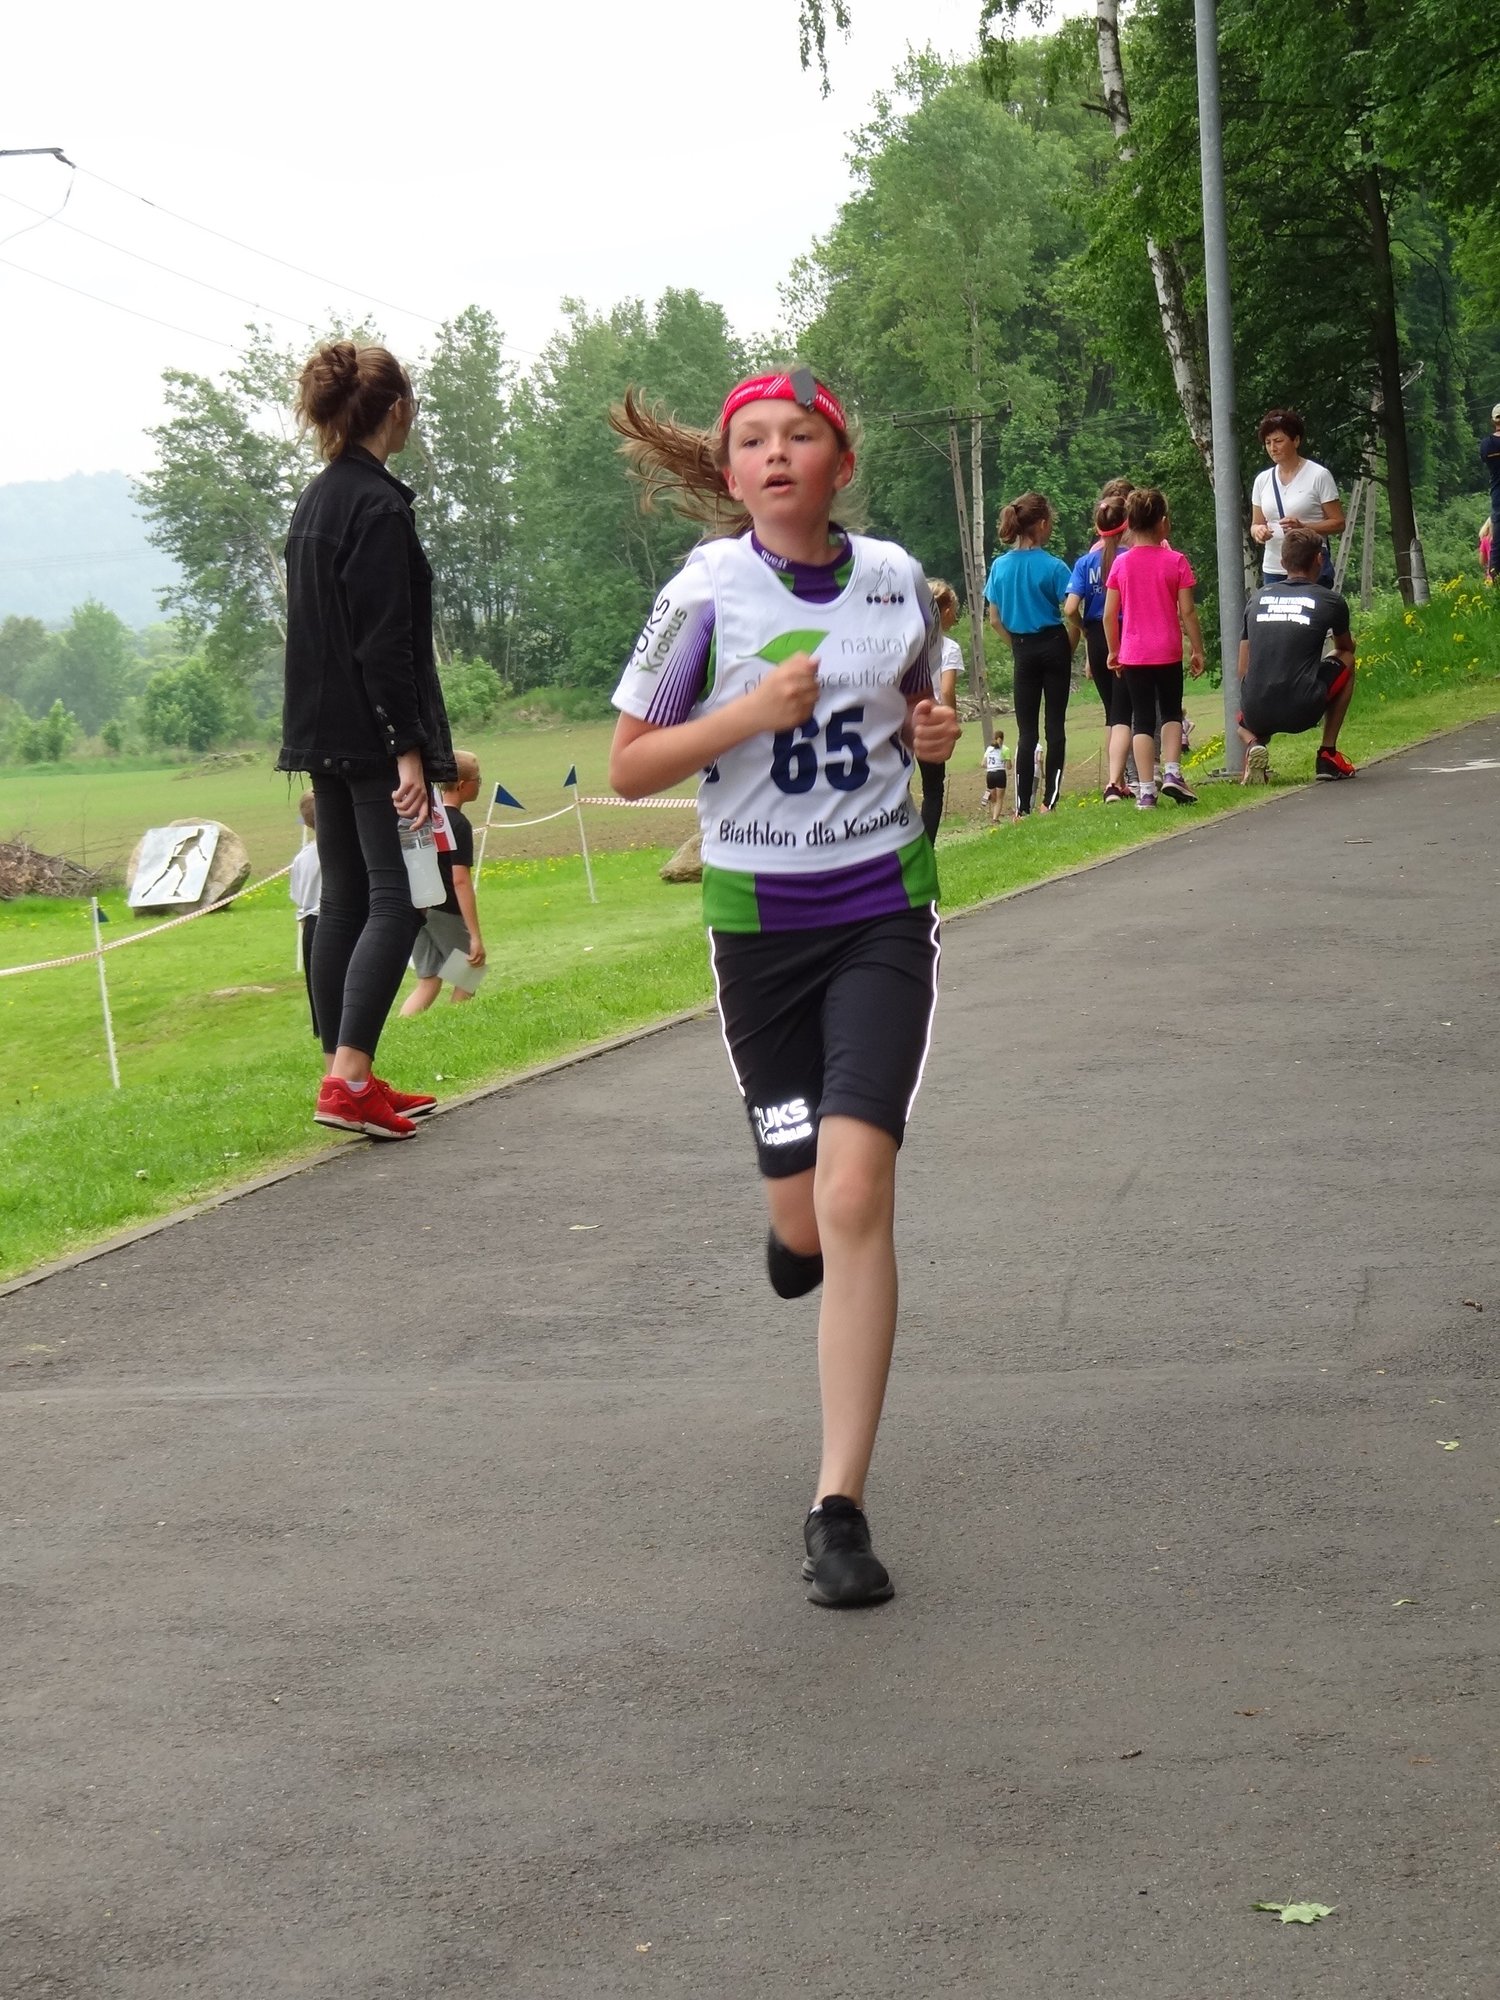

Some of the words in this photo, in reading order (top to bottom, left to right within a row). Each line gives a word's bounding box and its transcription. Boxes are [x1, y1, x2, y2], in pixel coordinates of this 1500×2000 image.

[636, 595, 670, 653] UKS
[841, 632, 908, 655] natural
[770, 705, 870, 794] 65
[719, 819, 797, 848] Biathlon
[805, 821, 837, 847] dla
[760, 1098, 809, 1128] UKS
